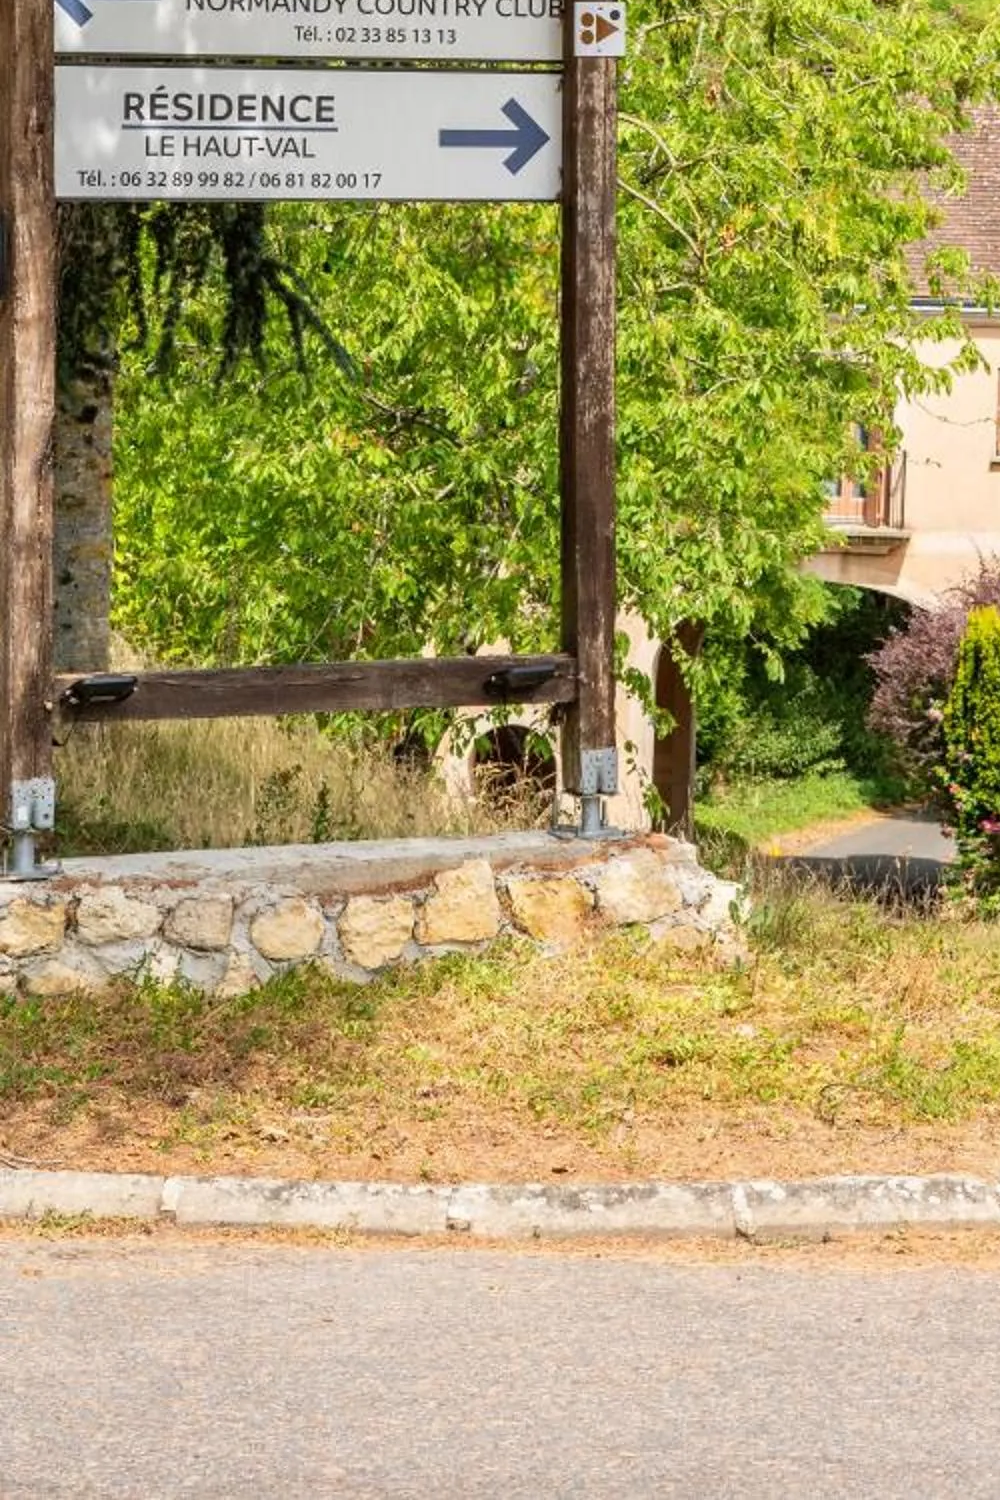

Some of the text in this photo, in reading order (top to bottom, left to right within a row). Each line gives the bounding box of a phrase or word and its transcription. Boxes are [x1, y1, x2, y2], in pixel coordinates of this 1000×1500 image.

[335, 27, 356, 43] 02
[360, 27, 381, 43] 33
[386, 28, 406, 43] 85
[412, 28, 431, 43] 13
[437, 29, 457, 44] 13
[123, 85, 335, 122] RÉSIDENCE
[145, 135, 316, 158] LE HAUT-VAL
[120, 171, 142, 187] 06
[147, 171, 167, 187] 32
[172, 171, 193, 187] 89
[198, 171, 219, 187] 99
[223, 171, 245, 187] 82
[259, 172, 281, 188] 06
[285, 173, 304, 188] 81
[311, 173, 331, 188] 82
[336, 173, 357, 188] 00
[363, 173, 382, 188] 17
